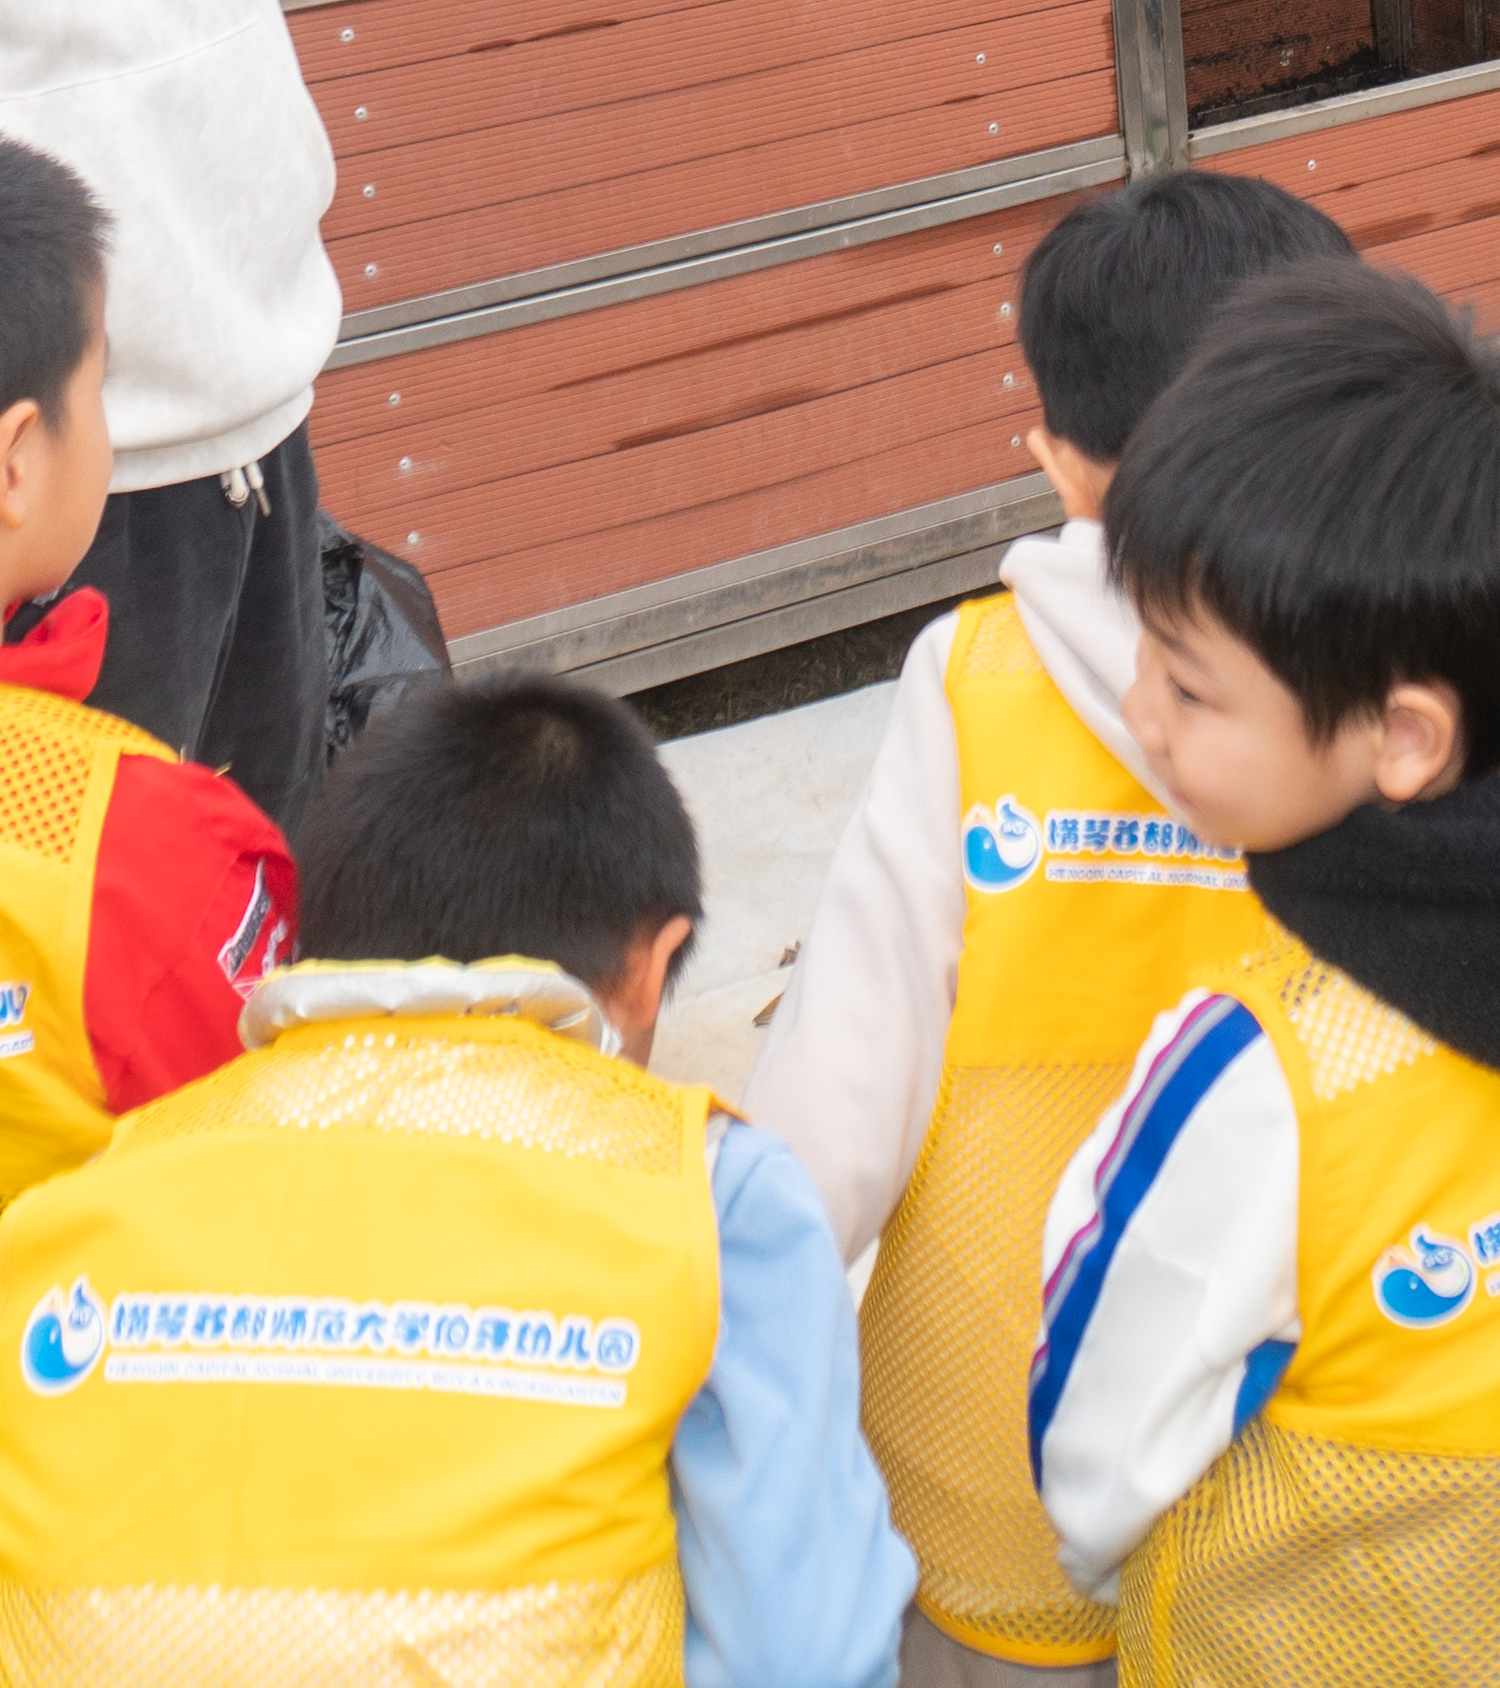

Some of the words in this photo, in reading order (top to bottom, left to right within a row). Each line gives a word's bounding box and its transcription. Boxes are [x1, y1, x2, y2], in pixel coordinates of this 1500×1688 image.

[1049, 817, 1241, 859] 横琴首都师
